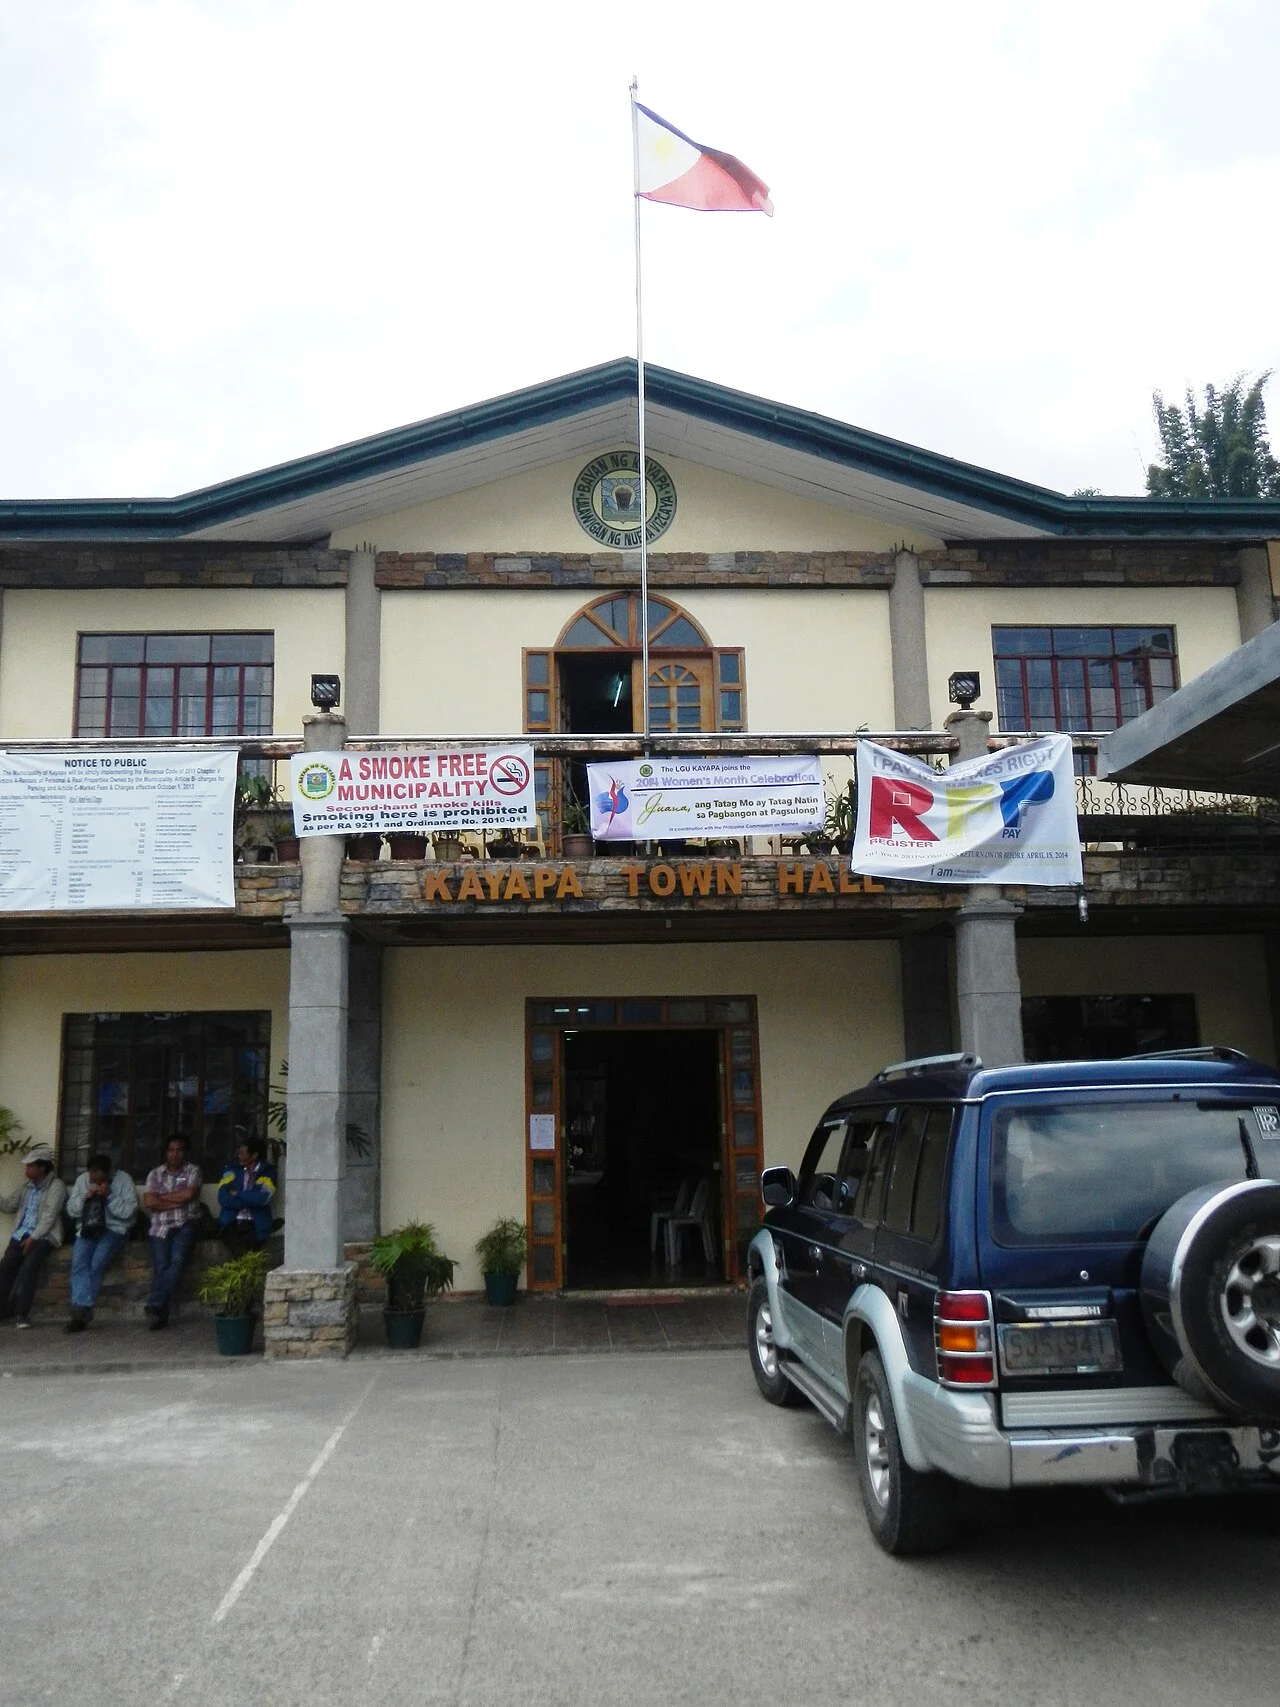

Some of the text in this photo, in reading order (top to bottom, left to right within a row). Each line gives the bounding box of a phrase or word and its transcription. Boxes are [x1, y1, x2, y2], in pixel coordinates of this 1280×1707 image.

[577, 459, 609, 494] BAYAN
[611, 454, 629, 468] NG
[576, 497, 609, 540] LALAWIGAN
[607, 531, 621, 545] NG
[649, 495, 673, 533] VIZCAYA
[64, 758, 147, 768] NOTICE TO PUBLIC
[338, 753, 488, 781] A SMOKE FREE
[881, 758, 912, 774] PAY
[661, 776, 712, 787] Women's
[713, 775, 748, 786] Month
[750, 772, 816, 784] Celebration
[337, 780, 489, 801] MUNICIPALITY
[326, 803, 418, 812] Second-hand
[694, 802, 712, 810] ang
[713, 800, 738, 809] Tatag
[756, 800, 767, 808] ay
[768, 798, 793, 807] Tatag
[794, 796, 819, 804] Natin
[868, 775, 941, 842] R
[302, 806, 528, 822] Smoking here is prohibited
[708, 810, 758, 820] Pagbangon
[770, 806, 819, 818] Pagsulong!
[302, 824, 314, 832] As
[337, 822, 352, 830] RA
[1002, 829, 1021, 839] PAY
[869, 838, 933, 848] REGISTER
[1026, 851, 1046, 859] APRIL
[1055, 851, 1069, 859] 2014
[930, 864, 935, 876] i
[936, 868, 953, 877] am
[423, 860, 885, 901] KAYAPA TOWN HALL
